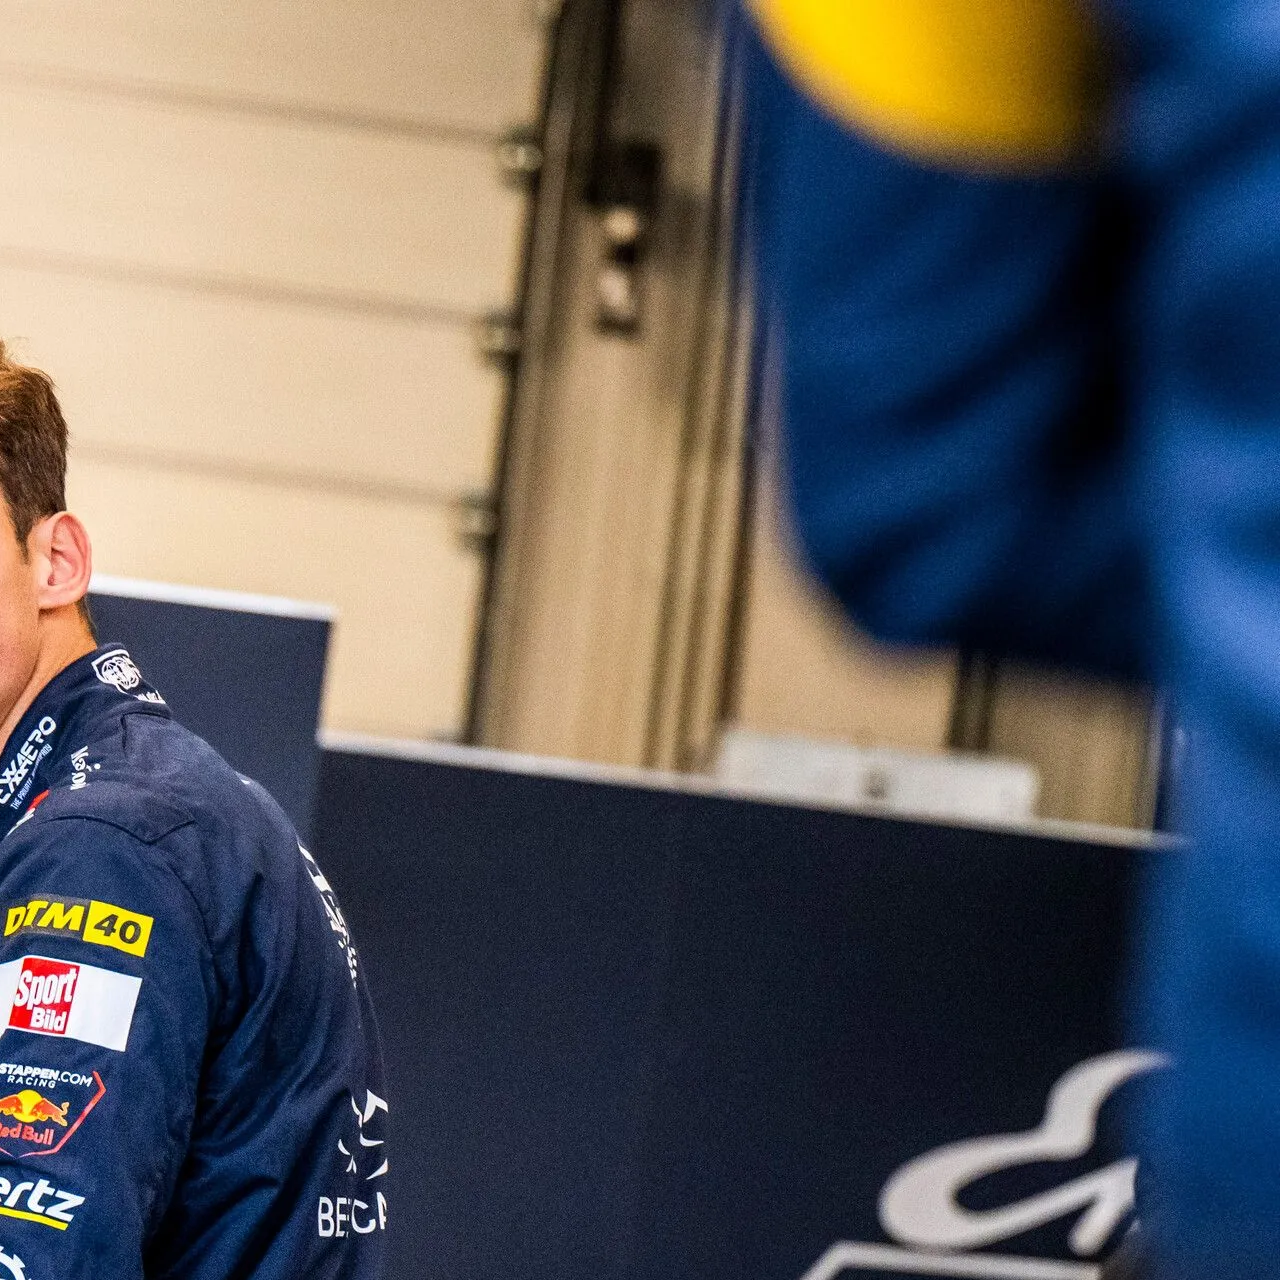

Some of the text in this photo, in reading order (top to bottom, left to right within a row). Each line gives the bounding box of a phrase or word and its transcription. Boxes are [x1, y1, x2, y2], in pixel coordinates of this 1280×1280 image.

[10, 797, 24, 810] THE
[4, 900, 141, 944] DTM 40
[14, 967, 77, 1010] Sport
[30, 1006, 67, 1031] Bild
[7, 1075, 56, 1089] RACING
[22, 1125, 54, 1146] Bull
